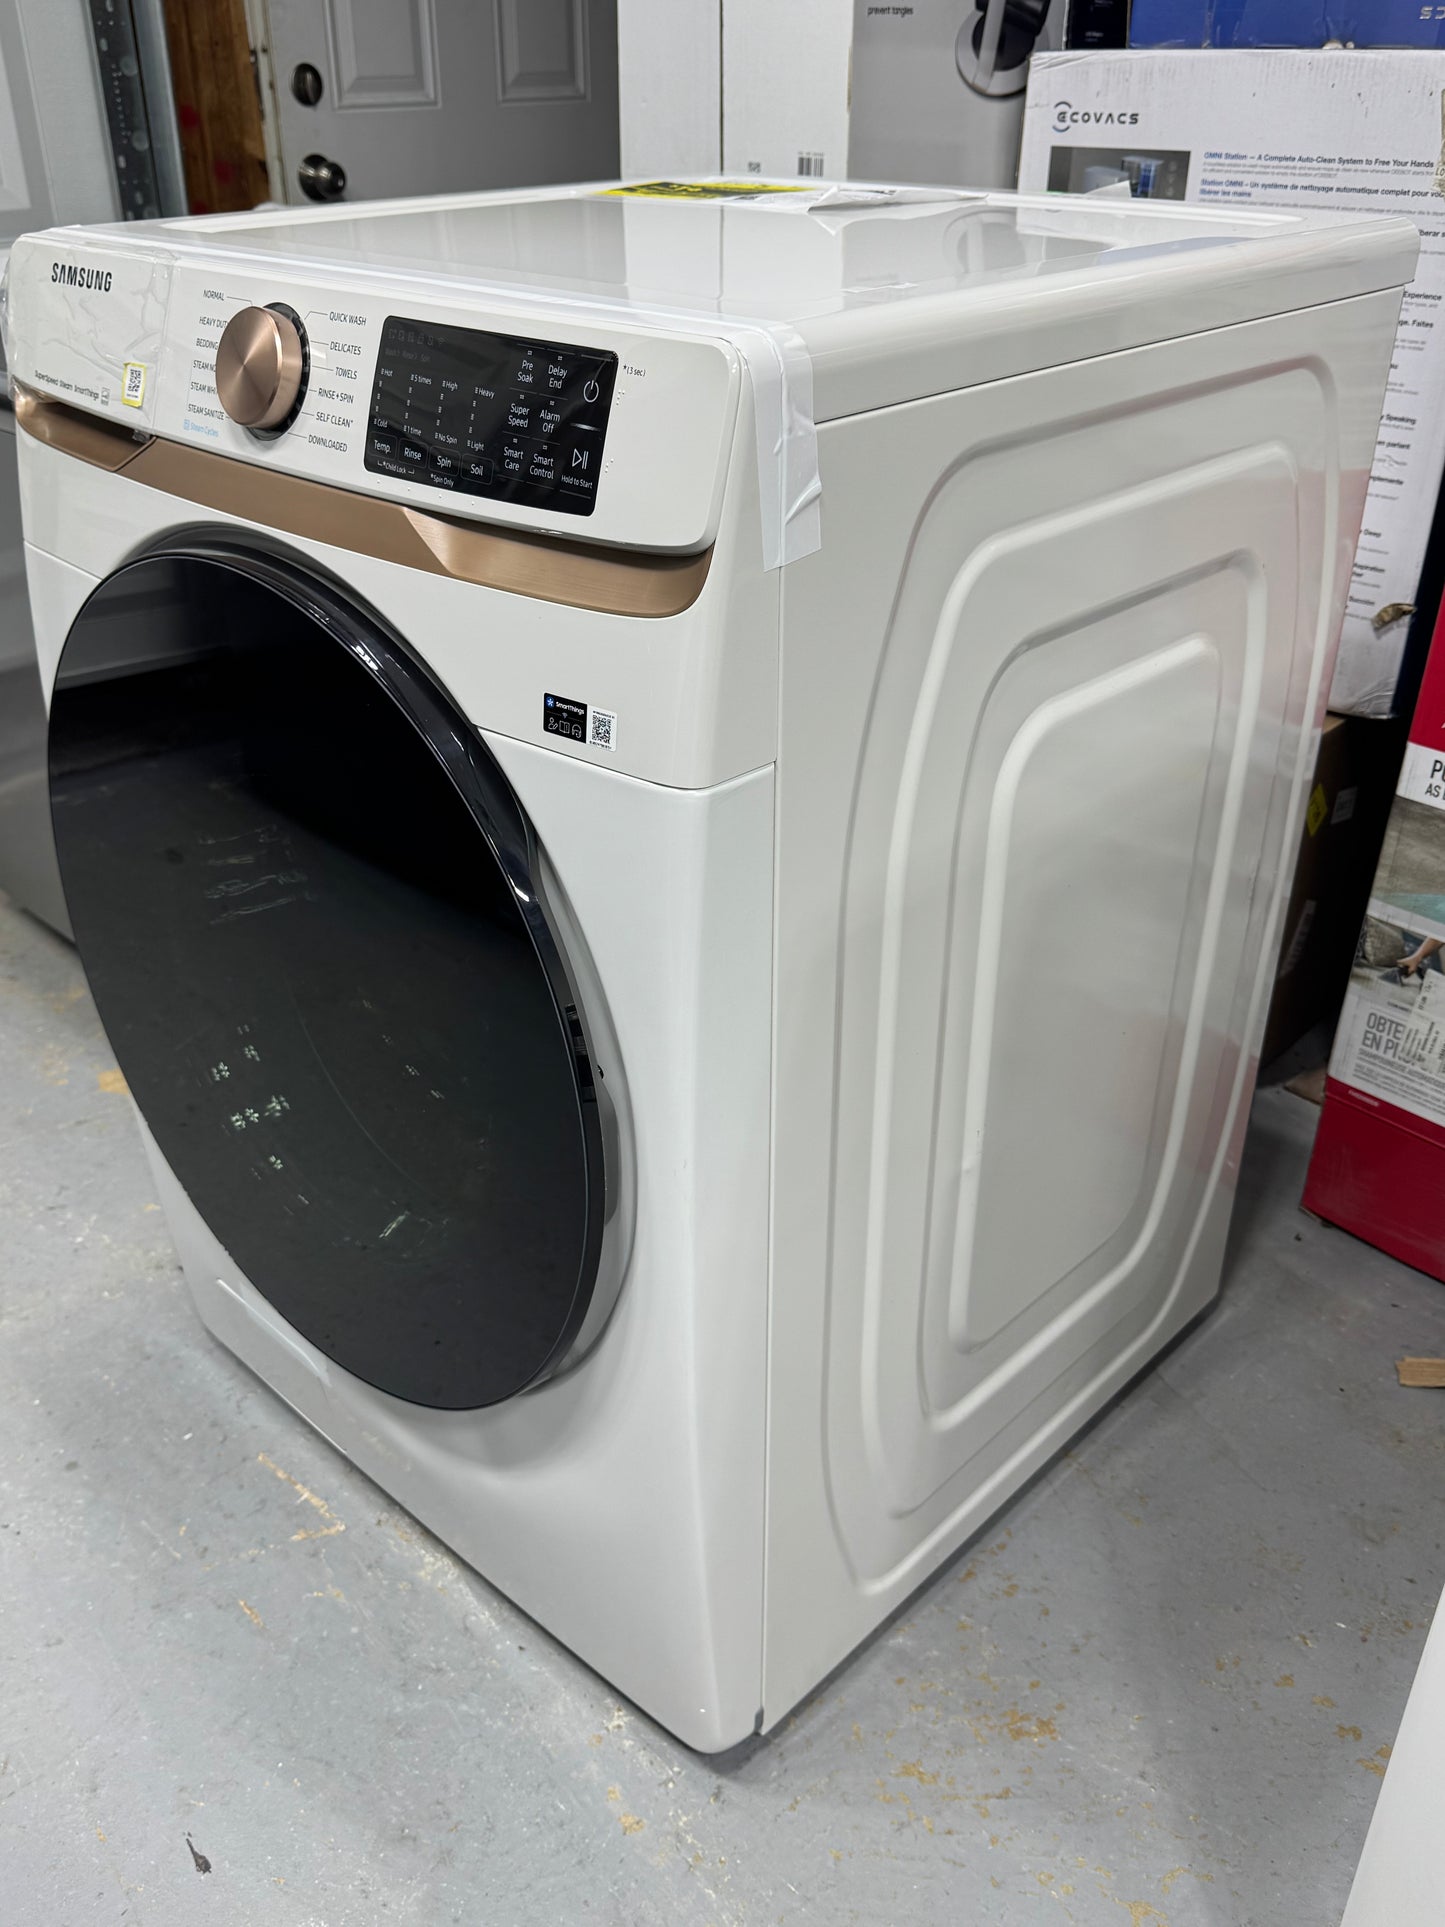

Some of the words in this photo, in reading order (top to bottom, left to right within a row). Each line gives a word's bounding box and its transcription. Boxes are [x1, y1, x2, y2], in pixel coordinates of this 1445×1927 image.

[1056, 110, 1140, 125] ECOVACS
[1263, 154, 1296, 163] Complete
[1297, 156, 1336, 164] Auto-Clean
[1337, 157, 1364, 166] System
[1374, 158, 1391, 167] Free
[1392, 159, 1409, 168] Your
[1410, 160, 1434, 169] Hands
[1299, 184, 1334, 194] nettoyage
[1335, 187, 1379, 195] automatique
[1380, 188, 1410, 197] complet
[1411, 190, 1429, 198] pour
[1418, 229, 1441, 238] berar
[52, 262, 113, 293] SAMSUNG
[202, 289, 225, 301] NORMAL
[198, 316, 217, 327] HEAVY
[329, 311, 348, 323] QUICK
[348, 314, 367, 327] WASH
[195, 337, 219, 351] BEDDING
[329, 341, 362, 356] DELICATES
[192, 359, 210, 370] STEAM
[521, 359, 534, 371] Pre
[548, 364, 568, 378] Delay
[335, 366, 358, 381] TOWELS
[384, 369, 394, 377] Hot
[418, 374, 433, 386] times
[517, 371, 534, 384] Soak
[633, 368, 647, 378] sec)
[190, 381, 207, 392] STEAM
[445, 381, 458, 392] High
[548, 379, 563, 390] End
[317, 387, 336, 400] RINSE
[339, 392, 355, 405] SPIN
[479, 387, 496, 400] Heavy
[187, 403, 204, 415] STEAM
[203, 407, 225, 421] SANITIZE
[510, 402, 530, 416] Super
[539, 409, 561, 423] Alarm
[315, 411, 331, 424] SELF
[377, 418, 388, 429] Cold
[507, 415, 529, 429] Speed
[410, 426, 422, 437] time
[542, 422, 555, 434] Off
[308, 433, 348, 453] DOWNLOADED
[373, 439, 392, 454] Temp.
[438, 433, 446, 442] No
[445, 434, 458, 446] Spin
[470, 440, 485, 452] Light
[404, 446, 423, 461] Rinse
[503, 446, 524, 460] Smart
[436, 455, 453, 469] Spin
[504, 459, 520, 472] Care
[533, 453, 554, 468] Smart
[396, 465, 407, 475] Lock
[470, 463, 484, 477] Soil
[529, 464, 555, 480] Control
[443, 477, 455, 488] Only
[561, 474, 574, 485] Hold
[573, 478, 580, 486] to
[579, 479, 593, 490] Start
[555, 701, 585, 716] SmartThings
[1424, 783, 1442, 798] AS
[1362, 1029, 1382, 1052] EN
